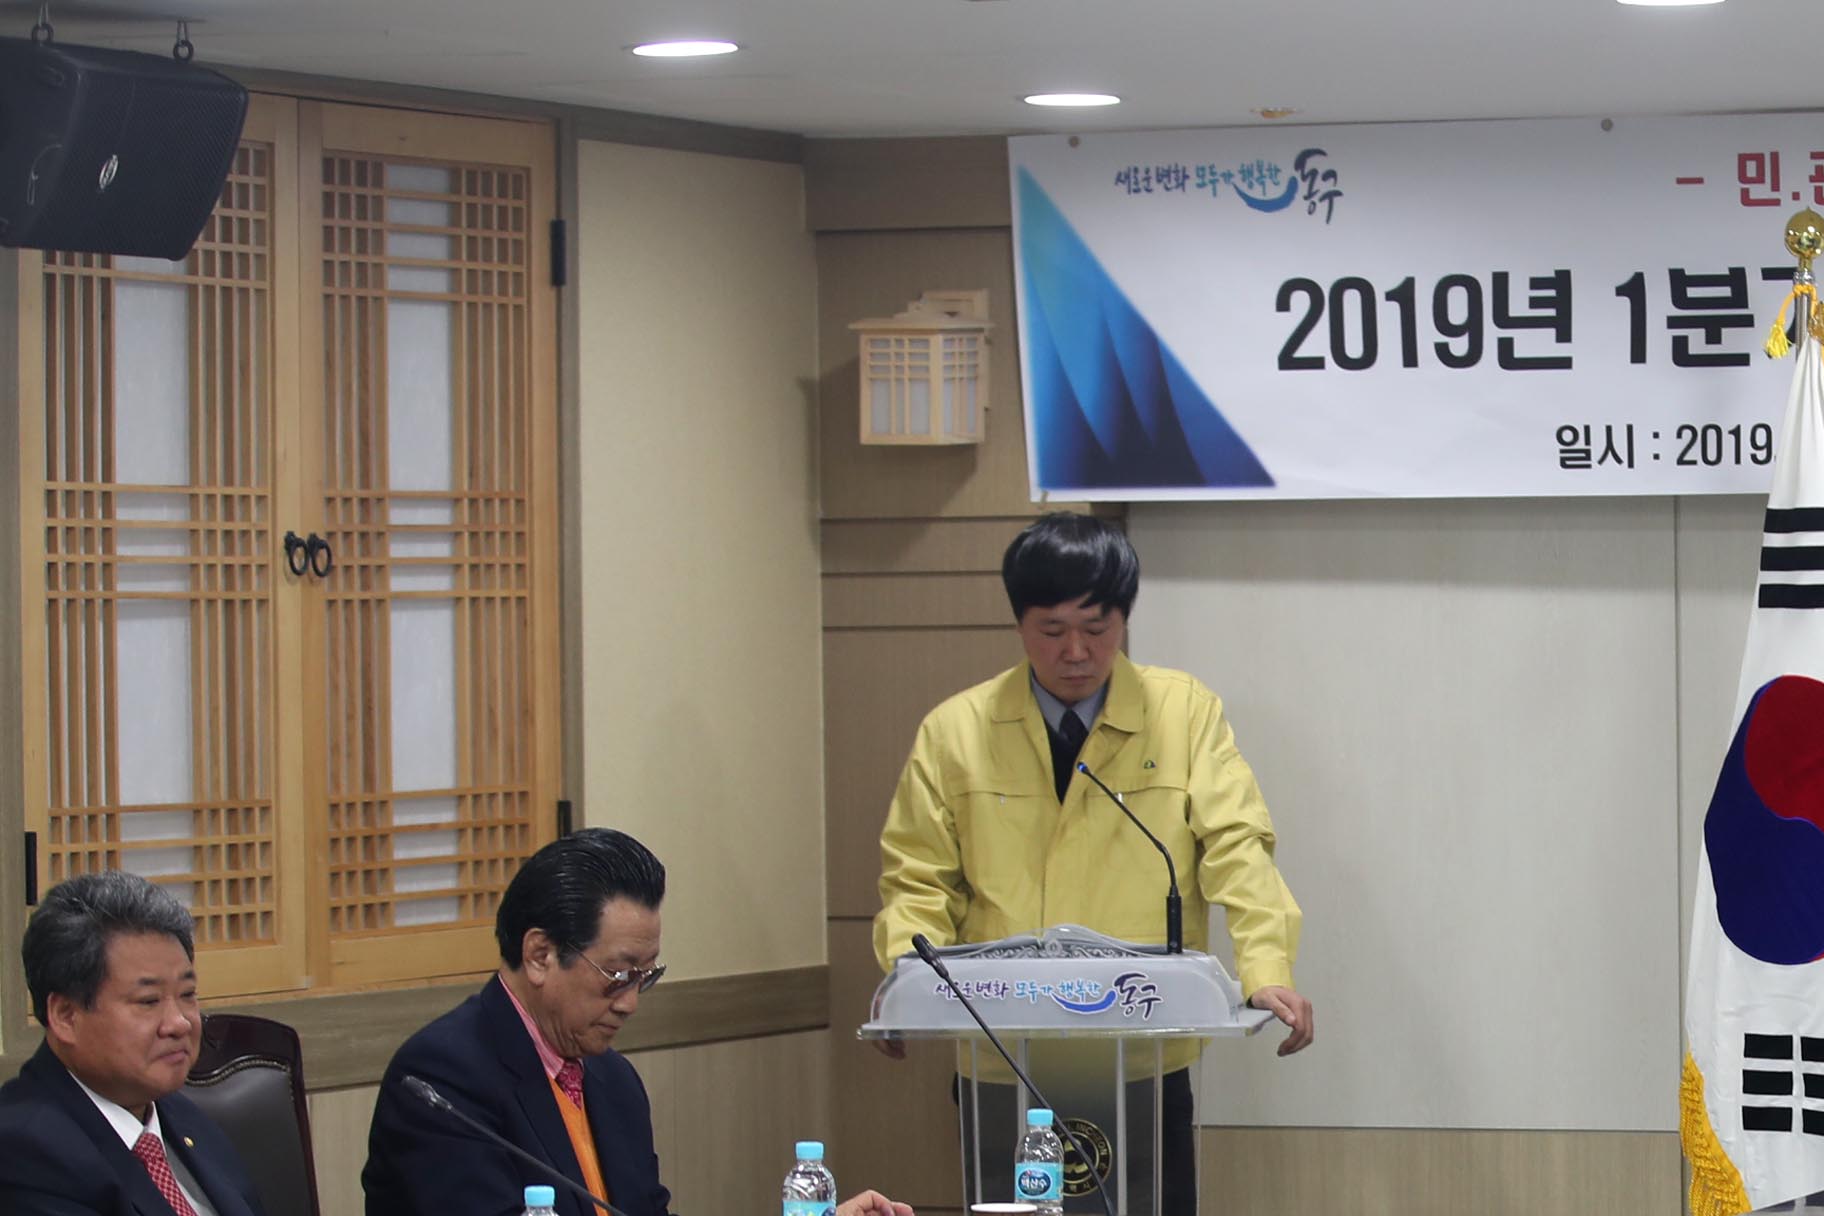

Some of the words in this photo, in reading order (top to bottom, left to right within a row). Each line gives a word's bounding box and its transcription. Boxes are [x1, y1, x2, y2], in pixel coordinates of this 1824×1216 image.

[1237, 160, 1282, 197] 행복한
[1294, 148, 1344, 224] 동구
[1275, 268, 1574, 372] 2019년
[1555, 423, 1635, 470] 일시
[1014, 980, 1051, 1002] 모두가
[1059, 980, 1100, 1001] 행복한
[1114, 973, 1162, 1018] 동구
